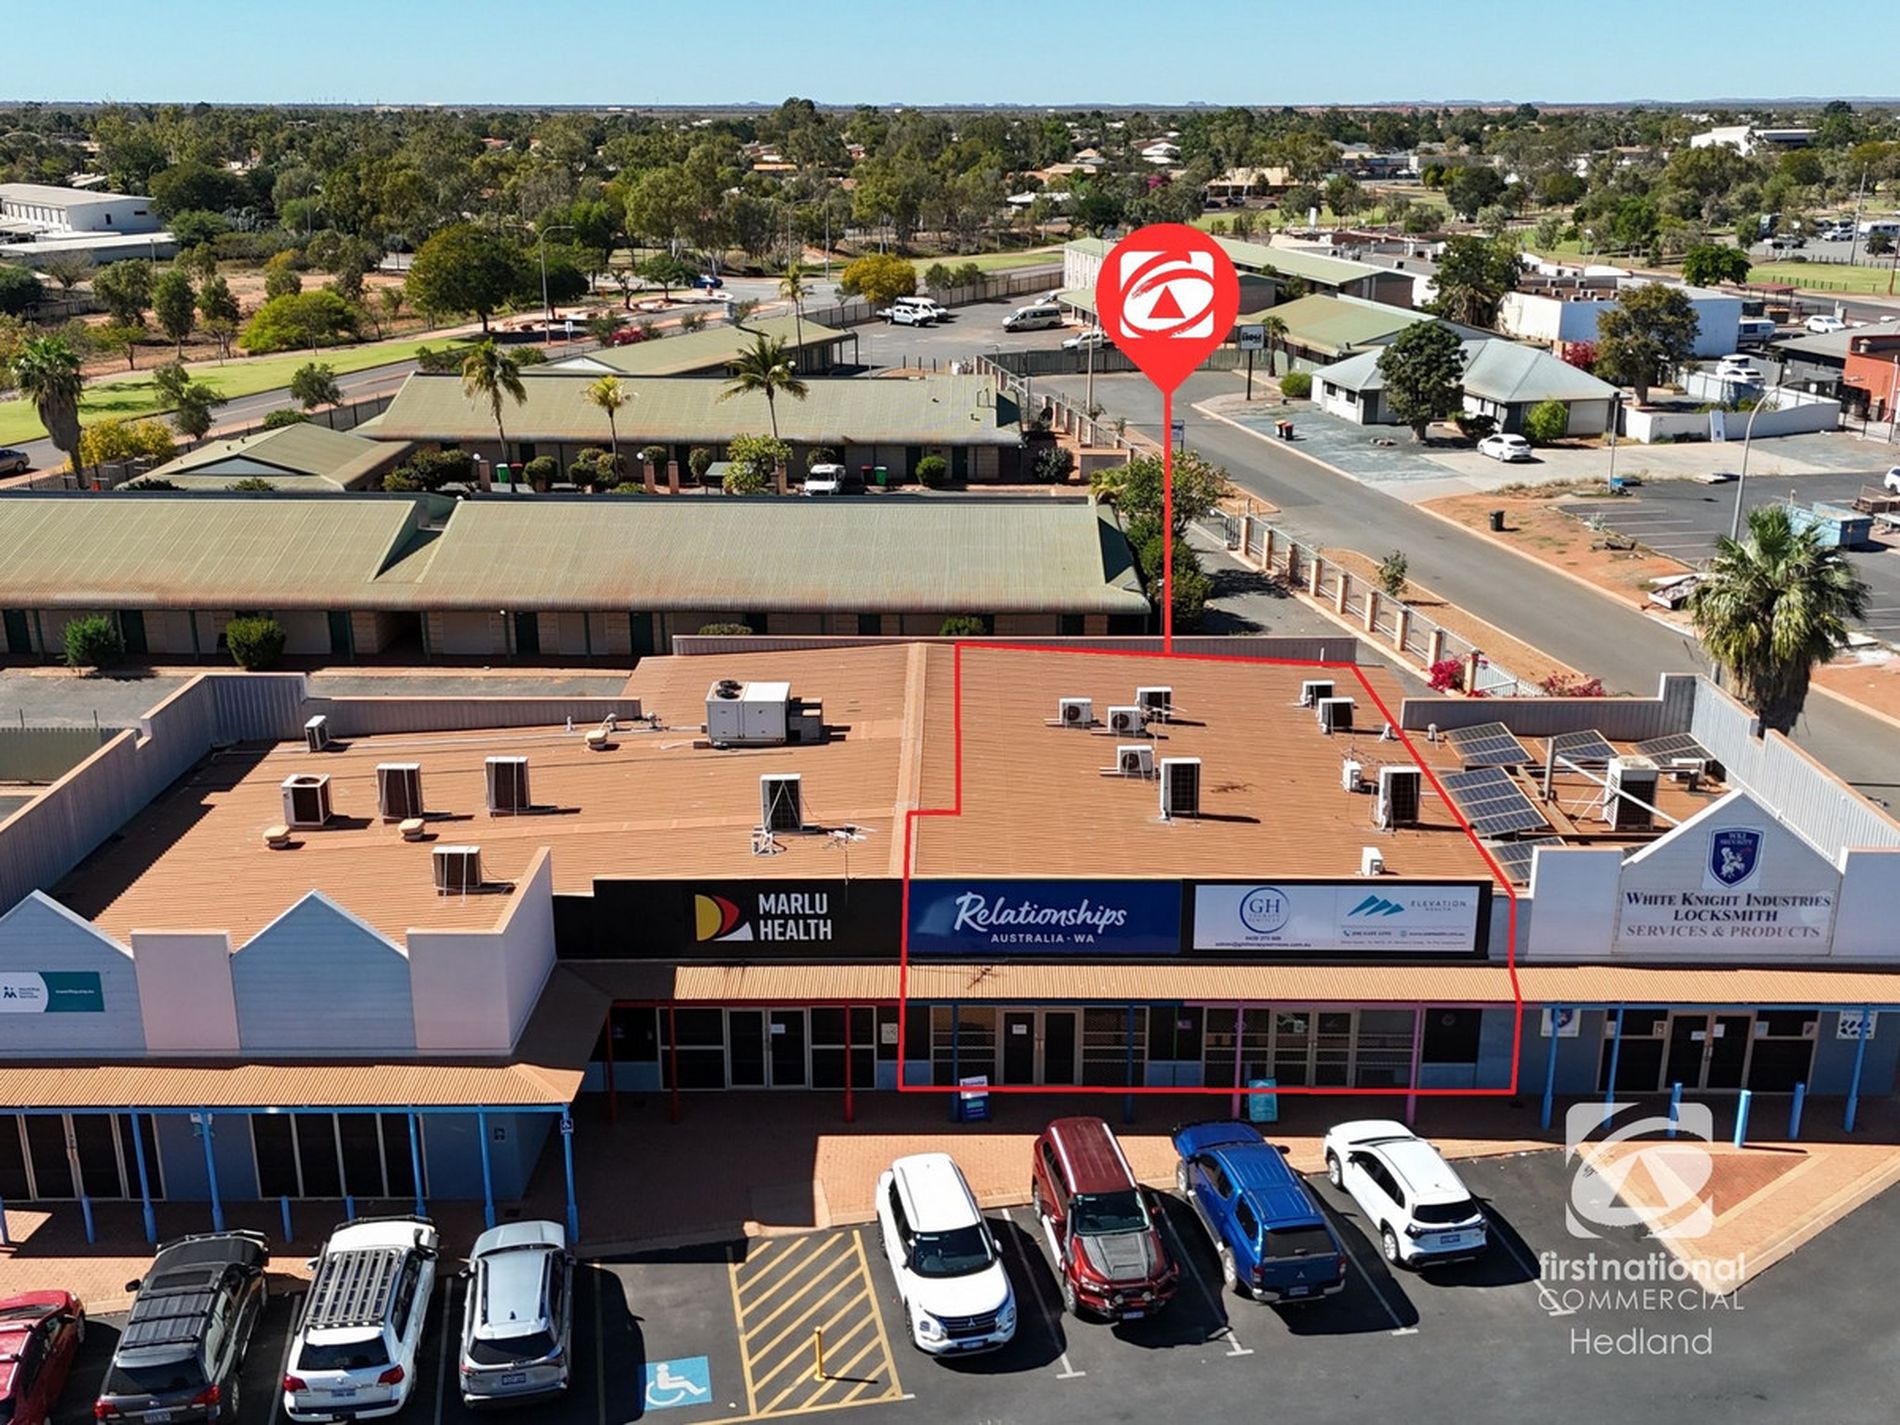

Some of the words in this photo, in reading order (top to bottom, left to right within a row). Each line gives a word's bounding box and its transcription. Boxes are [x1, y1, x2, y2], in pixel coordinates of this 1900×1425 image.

[758, 893, 828, 915] MARLU
[1249, 898, 1280, 914] GH
[1410, 900, 1467, 908] ELEVATION
[1626, 892, 1677, 906] WHITE
[1681, 892, 1741, 906] KNIGHT
[1746, 893, 1832, 907] INDUSTRIES
[954, 891, 1128, 934] Relationships
[1673, 909, 1779, 922] LOCKSMITH
[759, 919, 833, 941] HEALTH
[1626, 924, 1709, 937] SERVICES
[1712, 925, 1725, 937] &
[1730, 925, 1821, 938] PRODUCTS
[991, 933, 1064, 943] AUSTRALIA
[1074, 934, 1095, 943] WA
